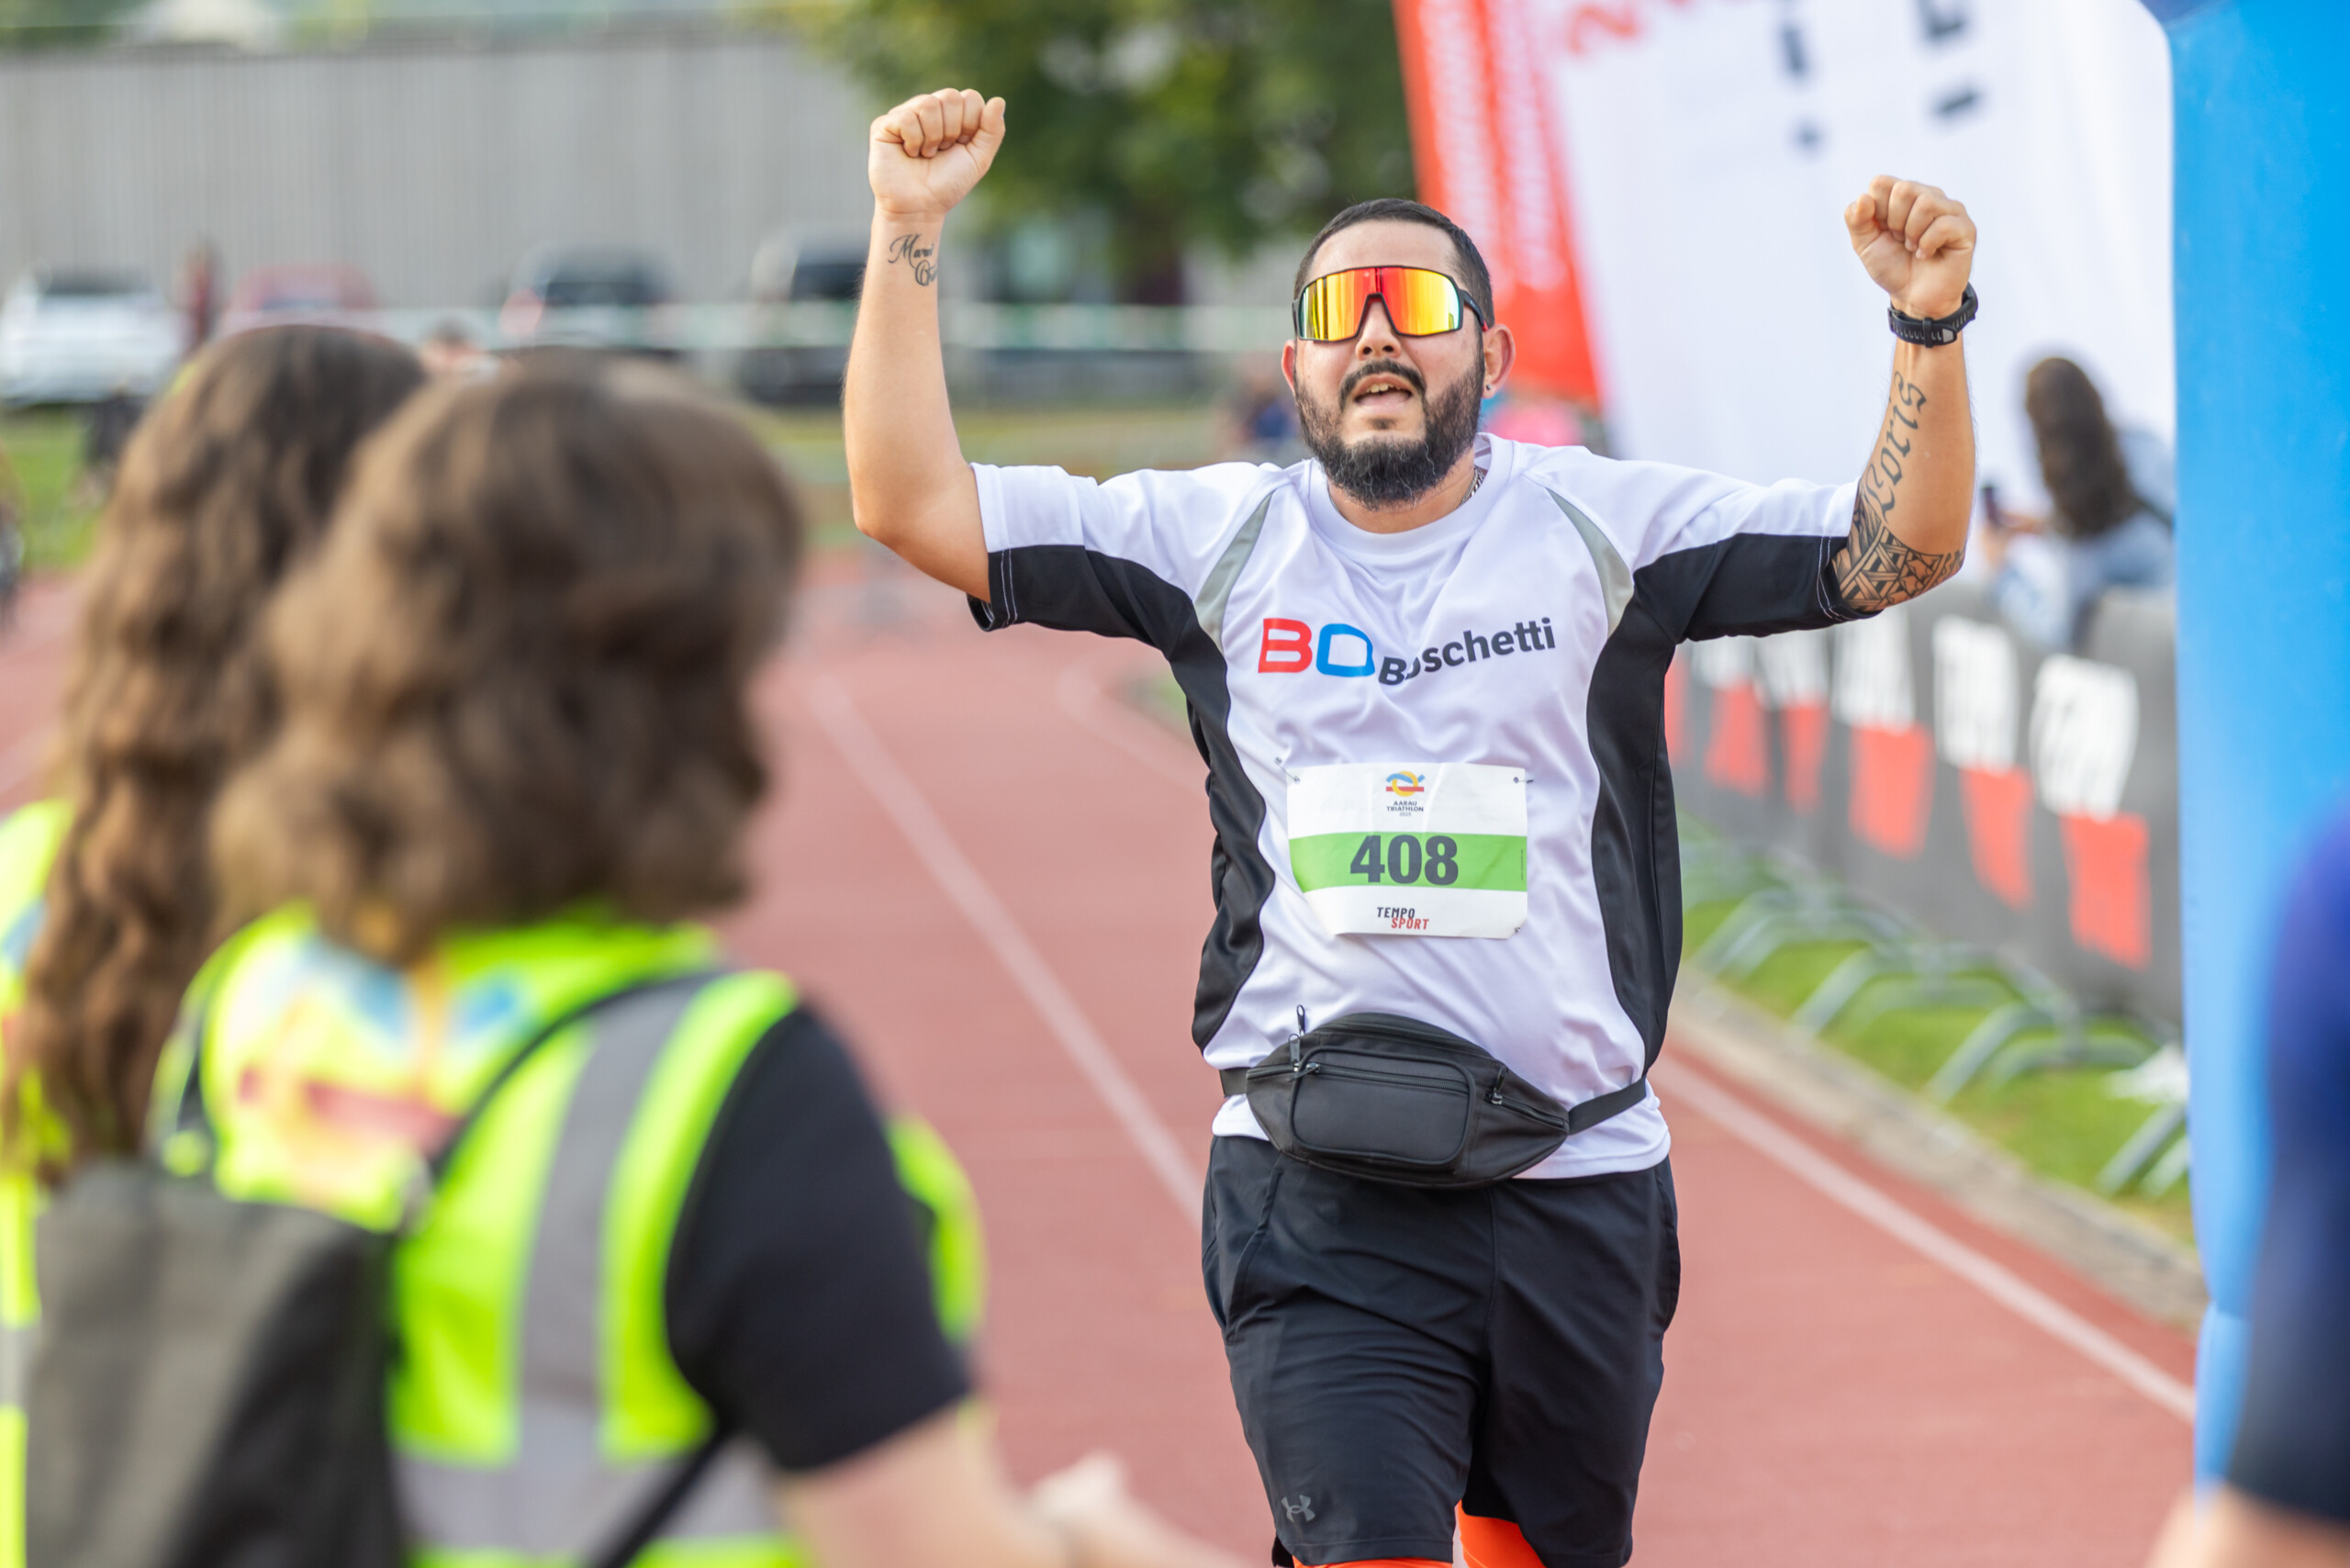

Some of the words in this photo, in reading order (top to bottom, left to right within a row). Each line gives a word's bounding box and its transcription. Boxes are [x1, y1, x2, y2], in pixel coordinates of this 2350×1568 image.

[1258, 618, 1375, 678] BO
[1350, 834, 1459, 885] 408
[1377, 907, 1415, 918] TEMPO
[1391, 917, 1429, 930] SPORT
